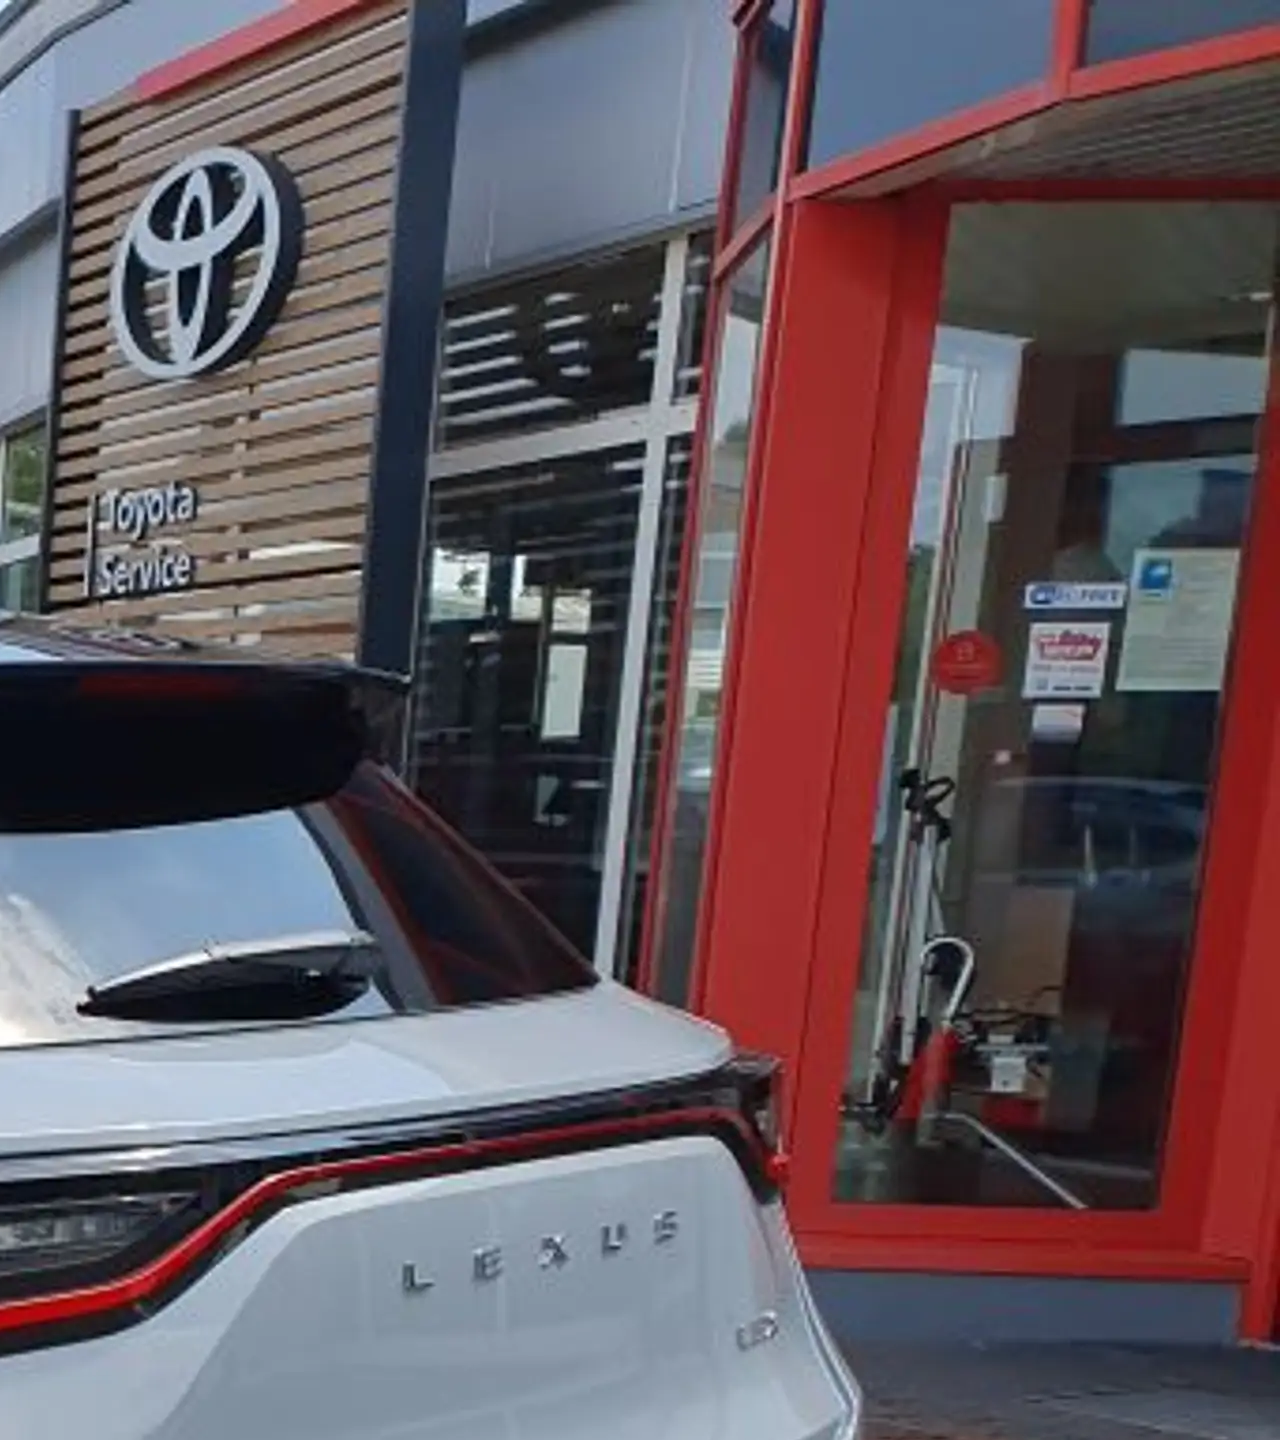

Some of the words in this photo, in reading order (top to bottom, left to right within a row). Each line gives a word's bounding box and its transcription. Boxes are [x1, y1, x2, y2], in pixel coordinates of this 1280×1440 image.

[100, 481, 195, 541] Toyota
[98, 548, 192, 594] Service
[401, 1208, 679, 1294] LEXUS
